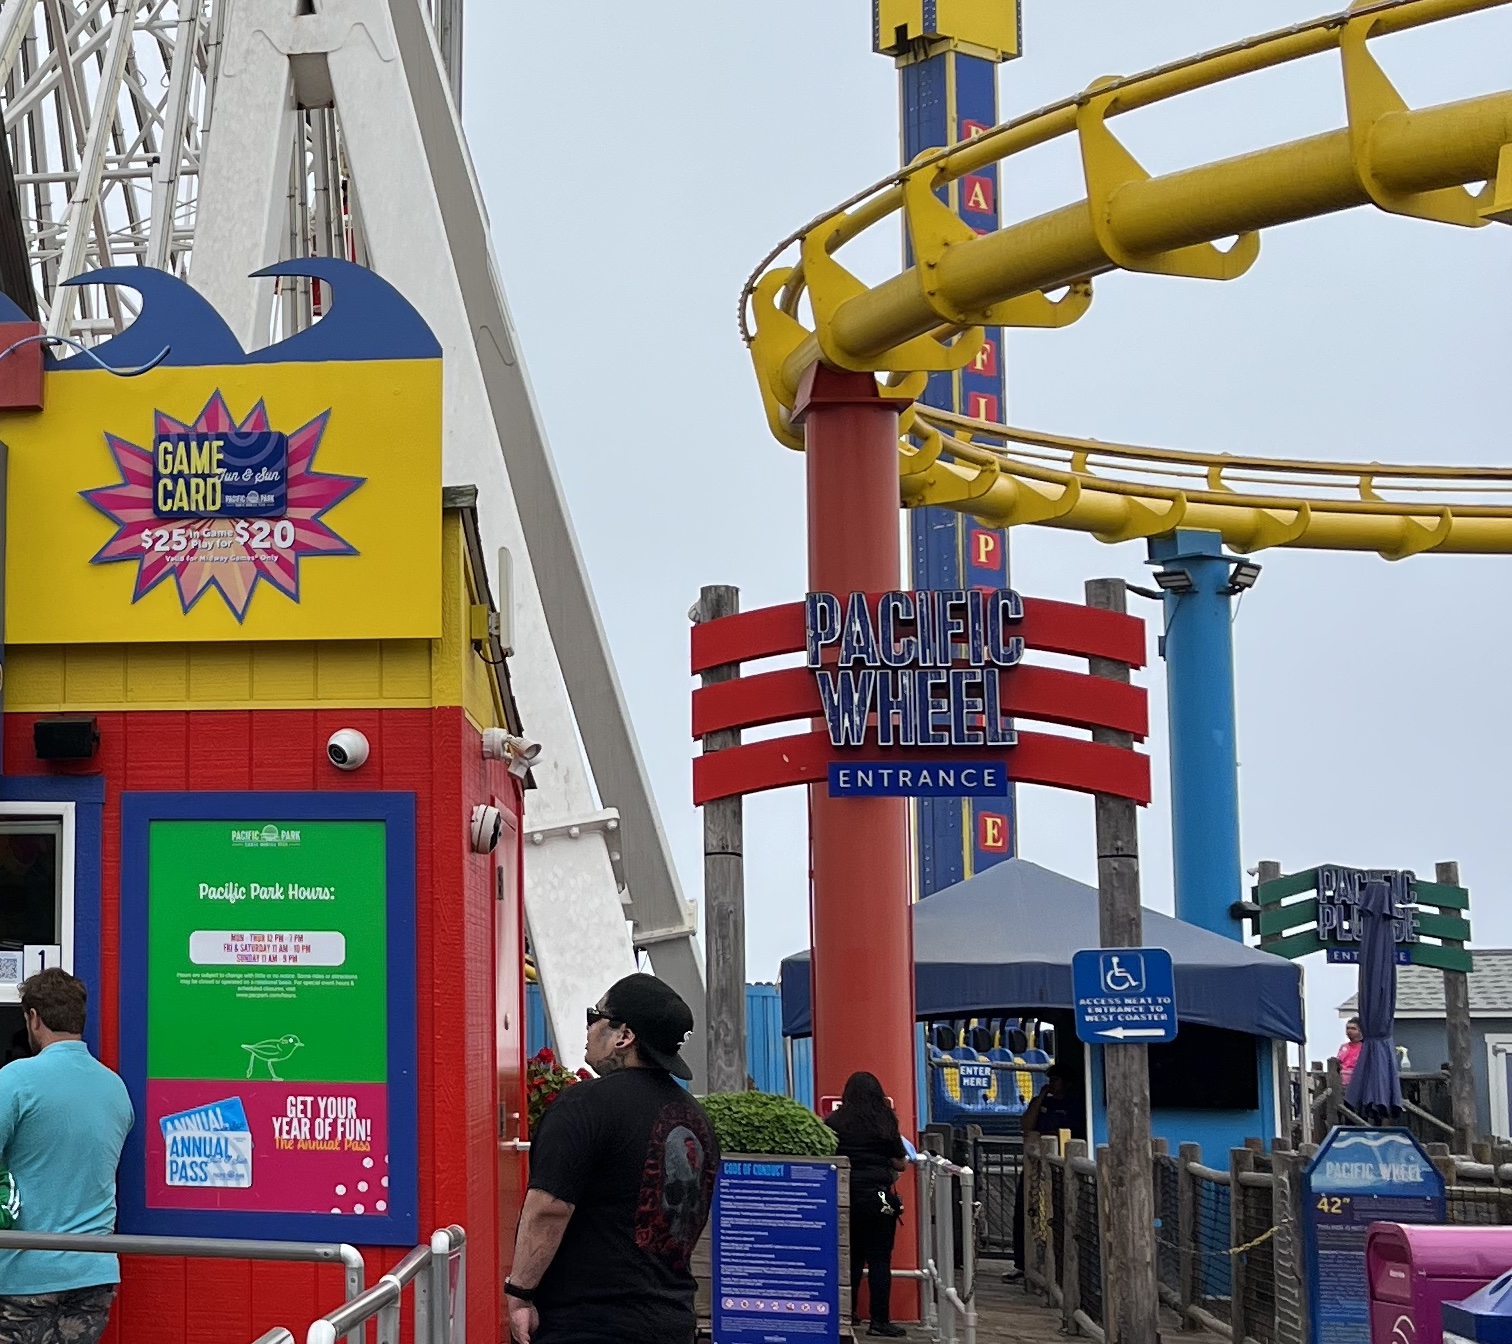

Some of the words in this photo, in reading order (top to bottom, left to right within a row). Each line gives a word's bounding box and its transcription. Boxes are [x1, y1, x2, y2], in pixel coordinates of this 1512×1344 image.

[158, 440, 224, 475] GAME
[242, 468, 253, 481] &
[255, 467, 280, 484] Sun
[158, 477, 222, 512] CARD
[260, 494, 275, 503] PARK
[140, 528, 187, 552] $25
[190, 529, 200, 538] In
[202, 529, 234, 537] Game
[235, 519, 296, 549] $20
[192, 539, 215, 550] Play
[216, 539, 233, 548] for
[199, 555, 229, 563] Midway
[805, 588, 1025, 669] PACIFIC
[816, 669, 1019, 748] WHEEL
[838, 769, 997, 788] ENTRANCE
[231, 830, 260, 841] PACIFIC
[281, 830, 301, 841] PARK
[199, 882, 246, 903] Pacific
[250, 883, 284, 900] Park
[288, 883, 335, 900] Hours:
[275, 934, 284, 942] PM
[223, 944, 232, 952] FRI
[240, 944, 270, 952] SATURDAY
[301, 945, 311, 953] PM
[37, 949, 46, 971] 1
[1079, 997, 1120, 1005] ACCESS
[1087, 1006, 1145, 1014] ENTRANCE
[1149, 1005, 1164, 1013] TO
[1084, 1014, 1115, 1022] WEST
[960, 1066, 991, 1076] ENTER
[962, 1077, 988, 1087] HERE
[287, 1096, 314, 1118] GET
[317, 1096, 357, 1119] YOUR
[272, 1117, 313, 1139] YEAR
[315, 1118, 332, 1140] OF
[337, 1118, 371, 1141] FUN!
[170, 1136, 232, 1158] ANNUAL
[274, 1137, 294, 1150] The
[297, 1137, 341, 1151] Annual
[344, 1138, 370, 1152] Pass
[169, 1161, 208, 1182] PASS
[724, 1163, 741, 1175] CODE
[743, 1163, 751, 1175] OF
[753, 1164, 784, 1176] CONDUCT
[1326, 1161, 1374, 1181] PACIFIC
[1379, 1163, 1424, 1182] WHEEL
[1316, 1197, 1351, 1214] 42"
